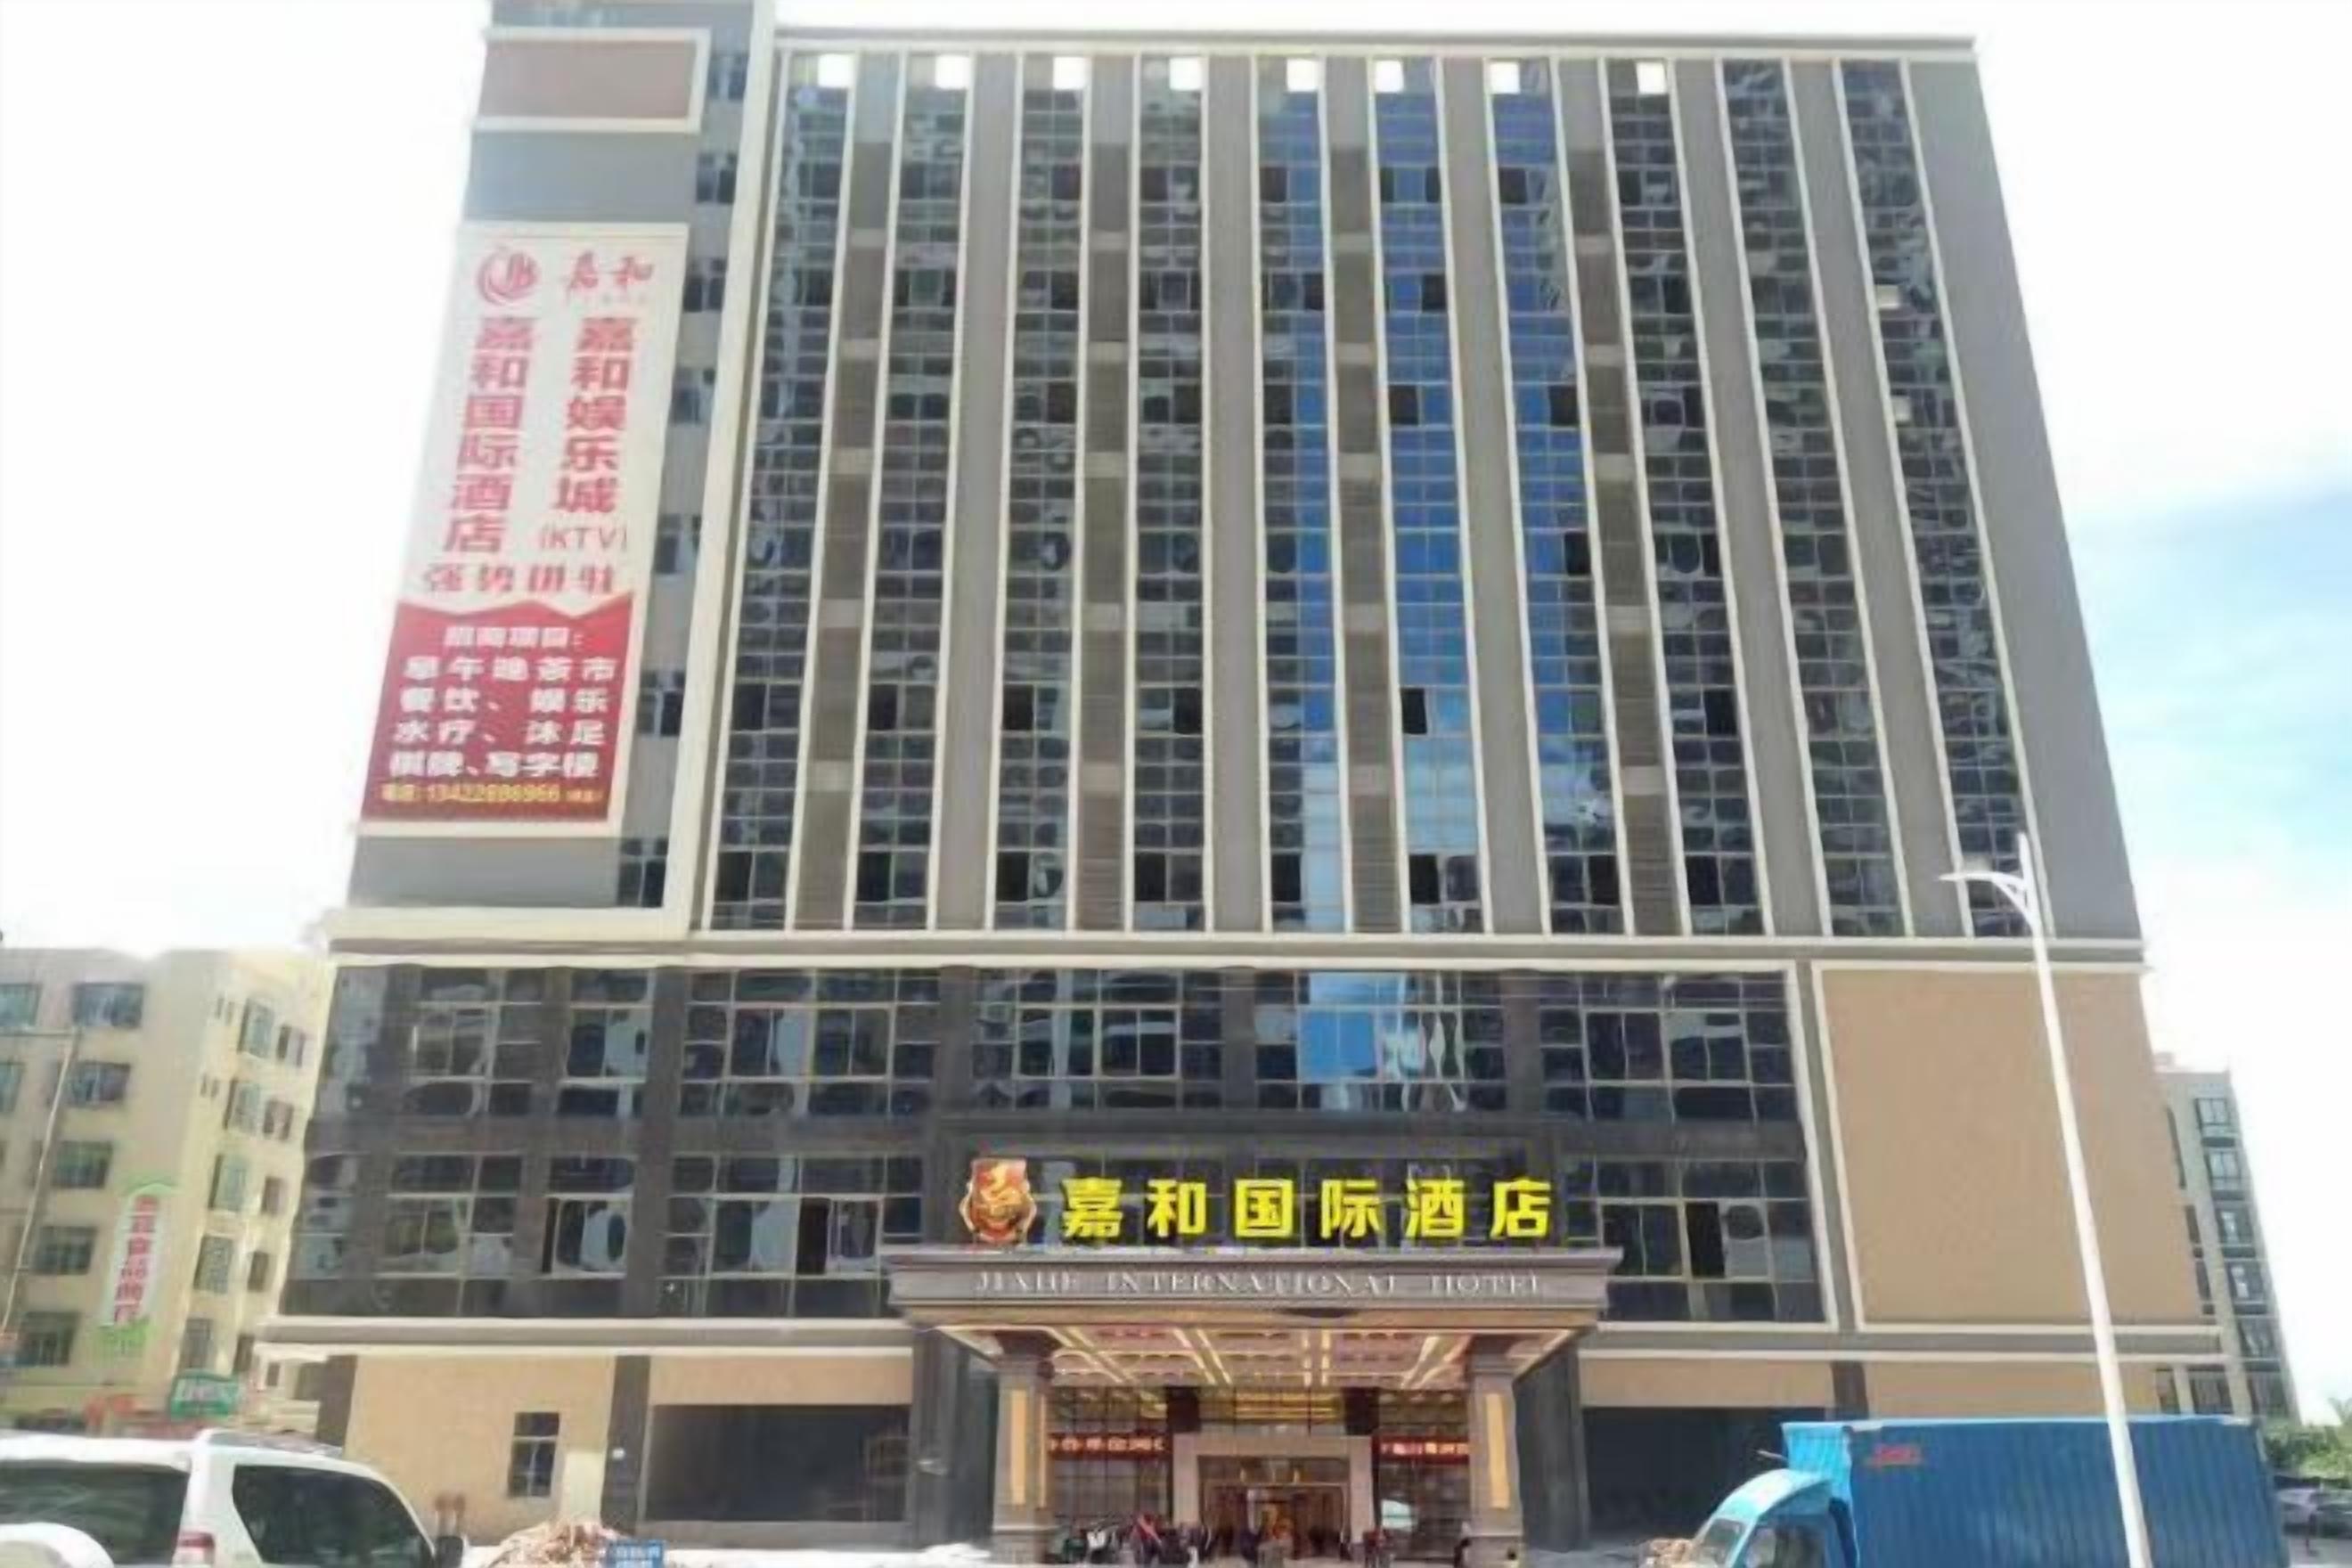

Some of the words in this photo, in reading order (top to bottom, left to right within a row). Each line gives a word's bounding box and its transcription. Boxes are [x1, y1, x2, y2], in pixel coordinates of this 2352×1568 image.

[444, 315, 537, 552] 嘉和国际酒店
[554, 315, 636, 513] 嘉和娱乐城
[1060, 1176, 1553, 1238] 嘉和国际酒店
[1107, 1271, 1406, 1294] INTERNATIONAL
[1427, 1273, 1546, 1294] HOTEL
